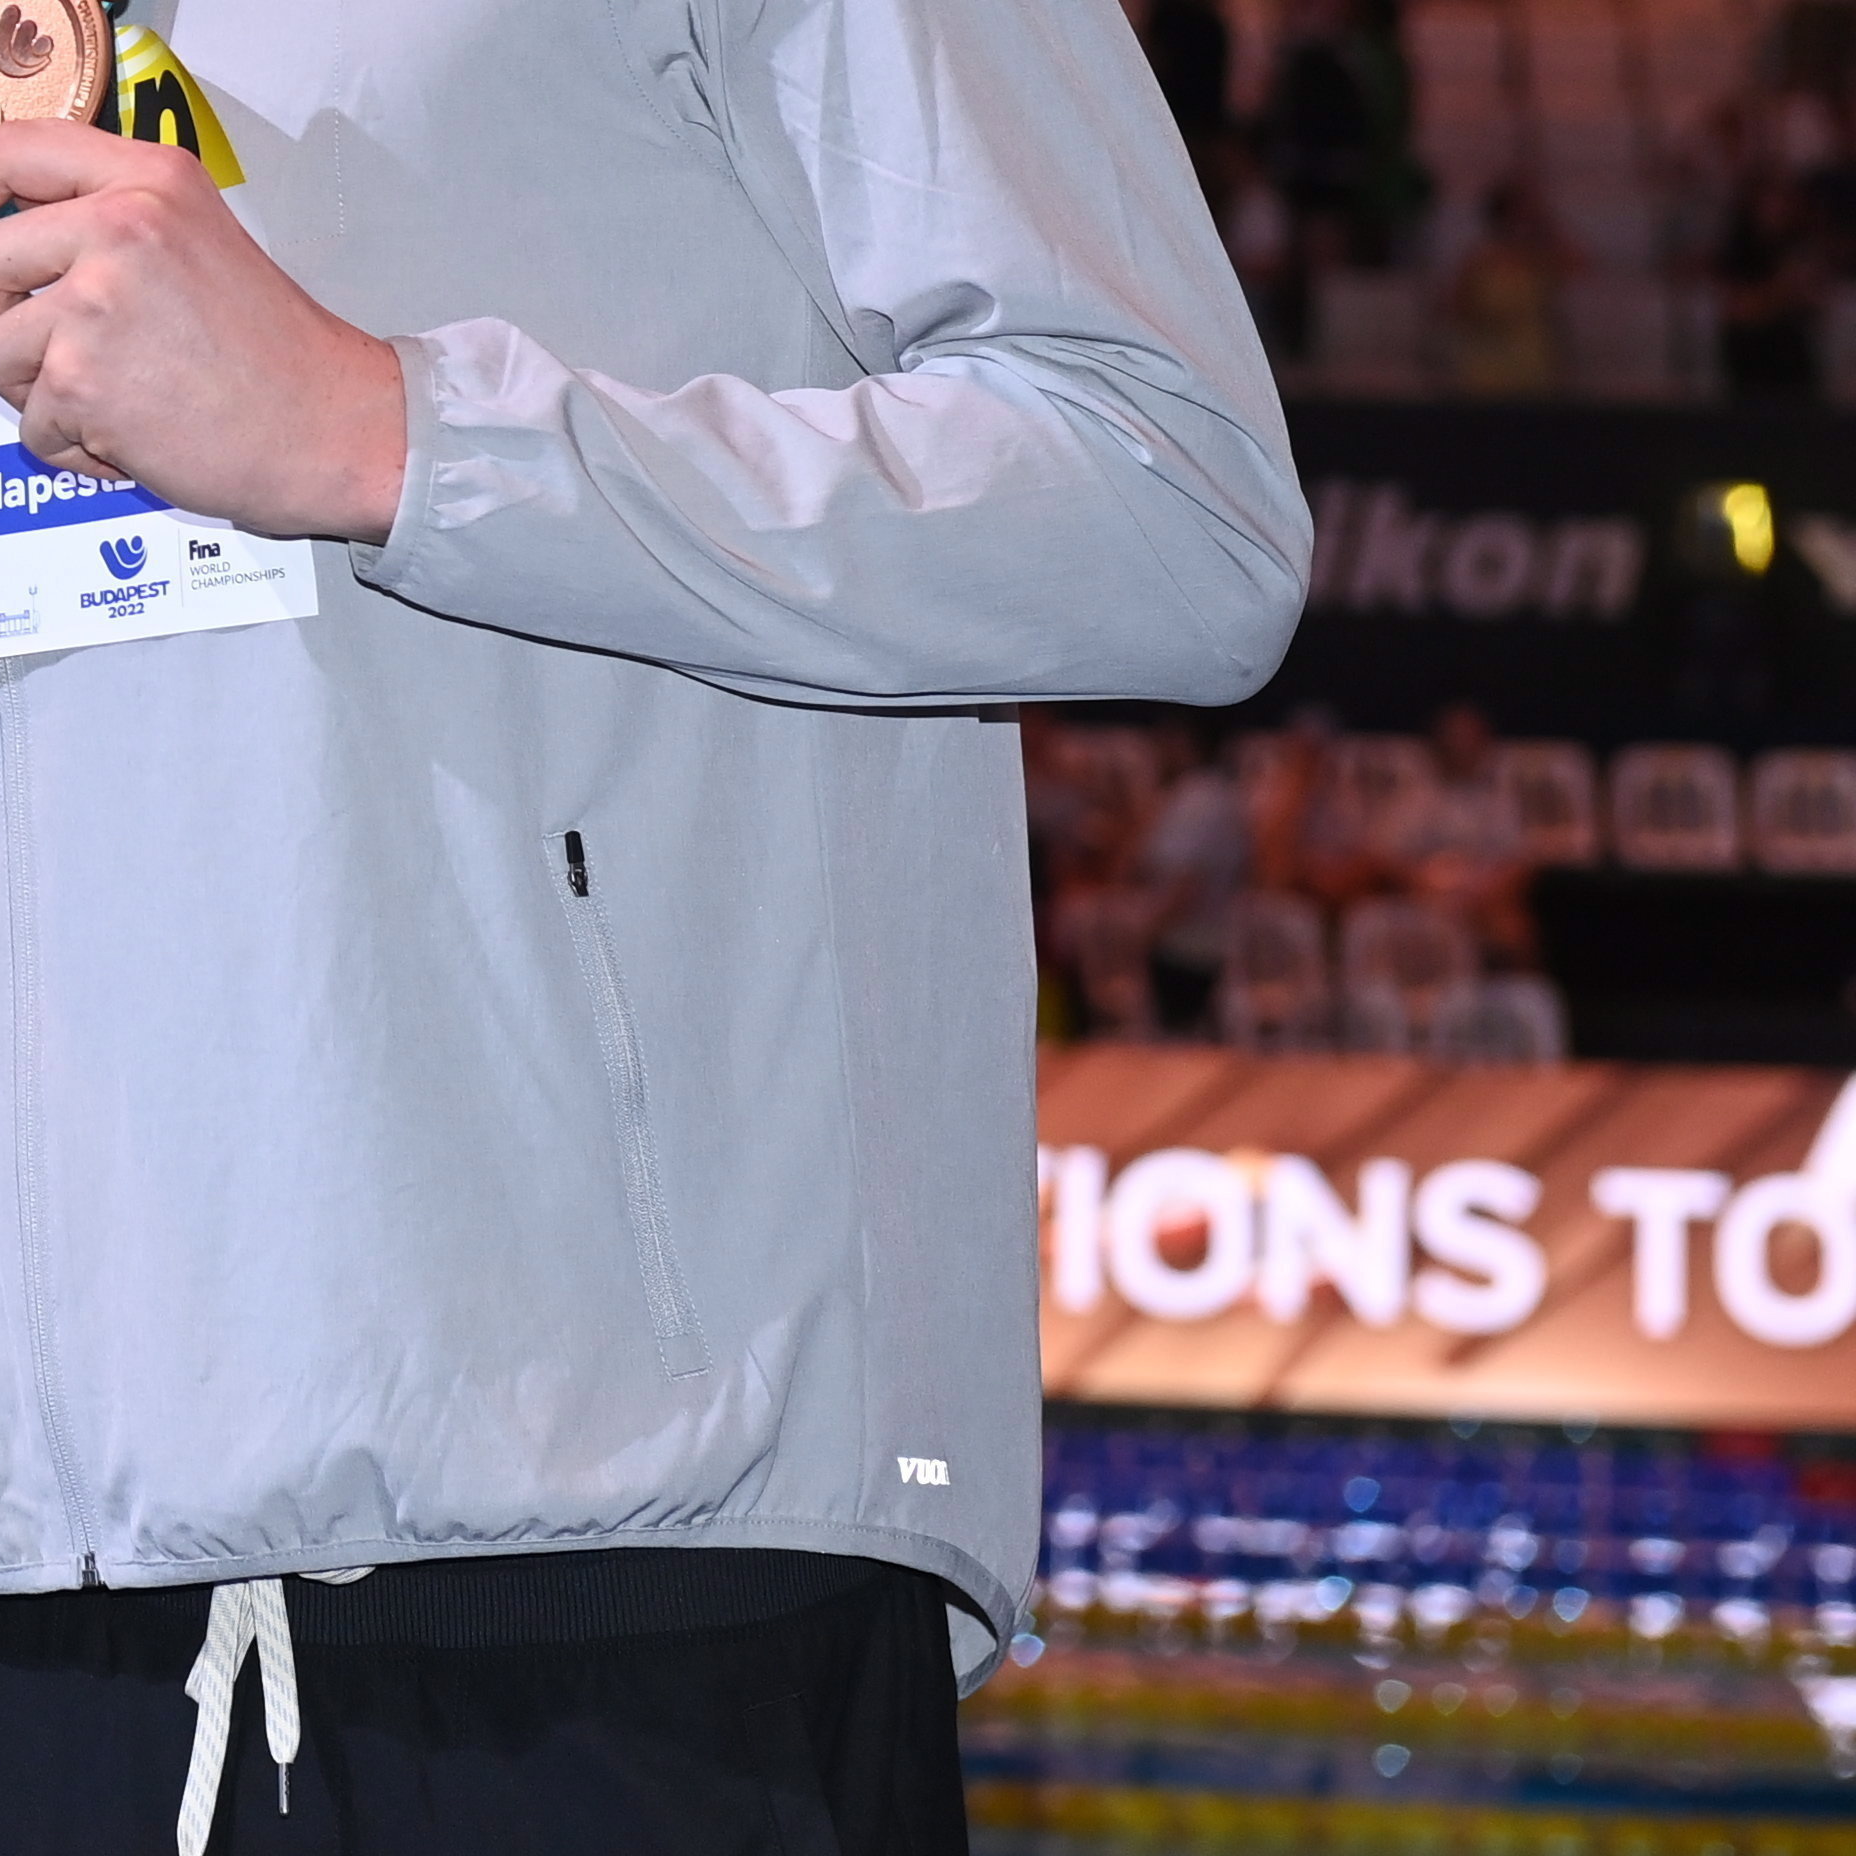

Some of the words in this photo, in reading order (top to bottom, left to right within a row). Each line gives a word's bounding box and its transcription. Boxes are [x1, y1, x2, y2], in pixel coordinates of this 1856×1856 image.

[188, 539, 221, 561] Fina
[189, 561, 231, 576] WORLD
[190, 567, 286, 590] CHAMPIONSHIPS
[79, 580, 170, 609] BUDAPEST
[107, 602, 145, 619] 2022
